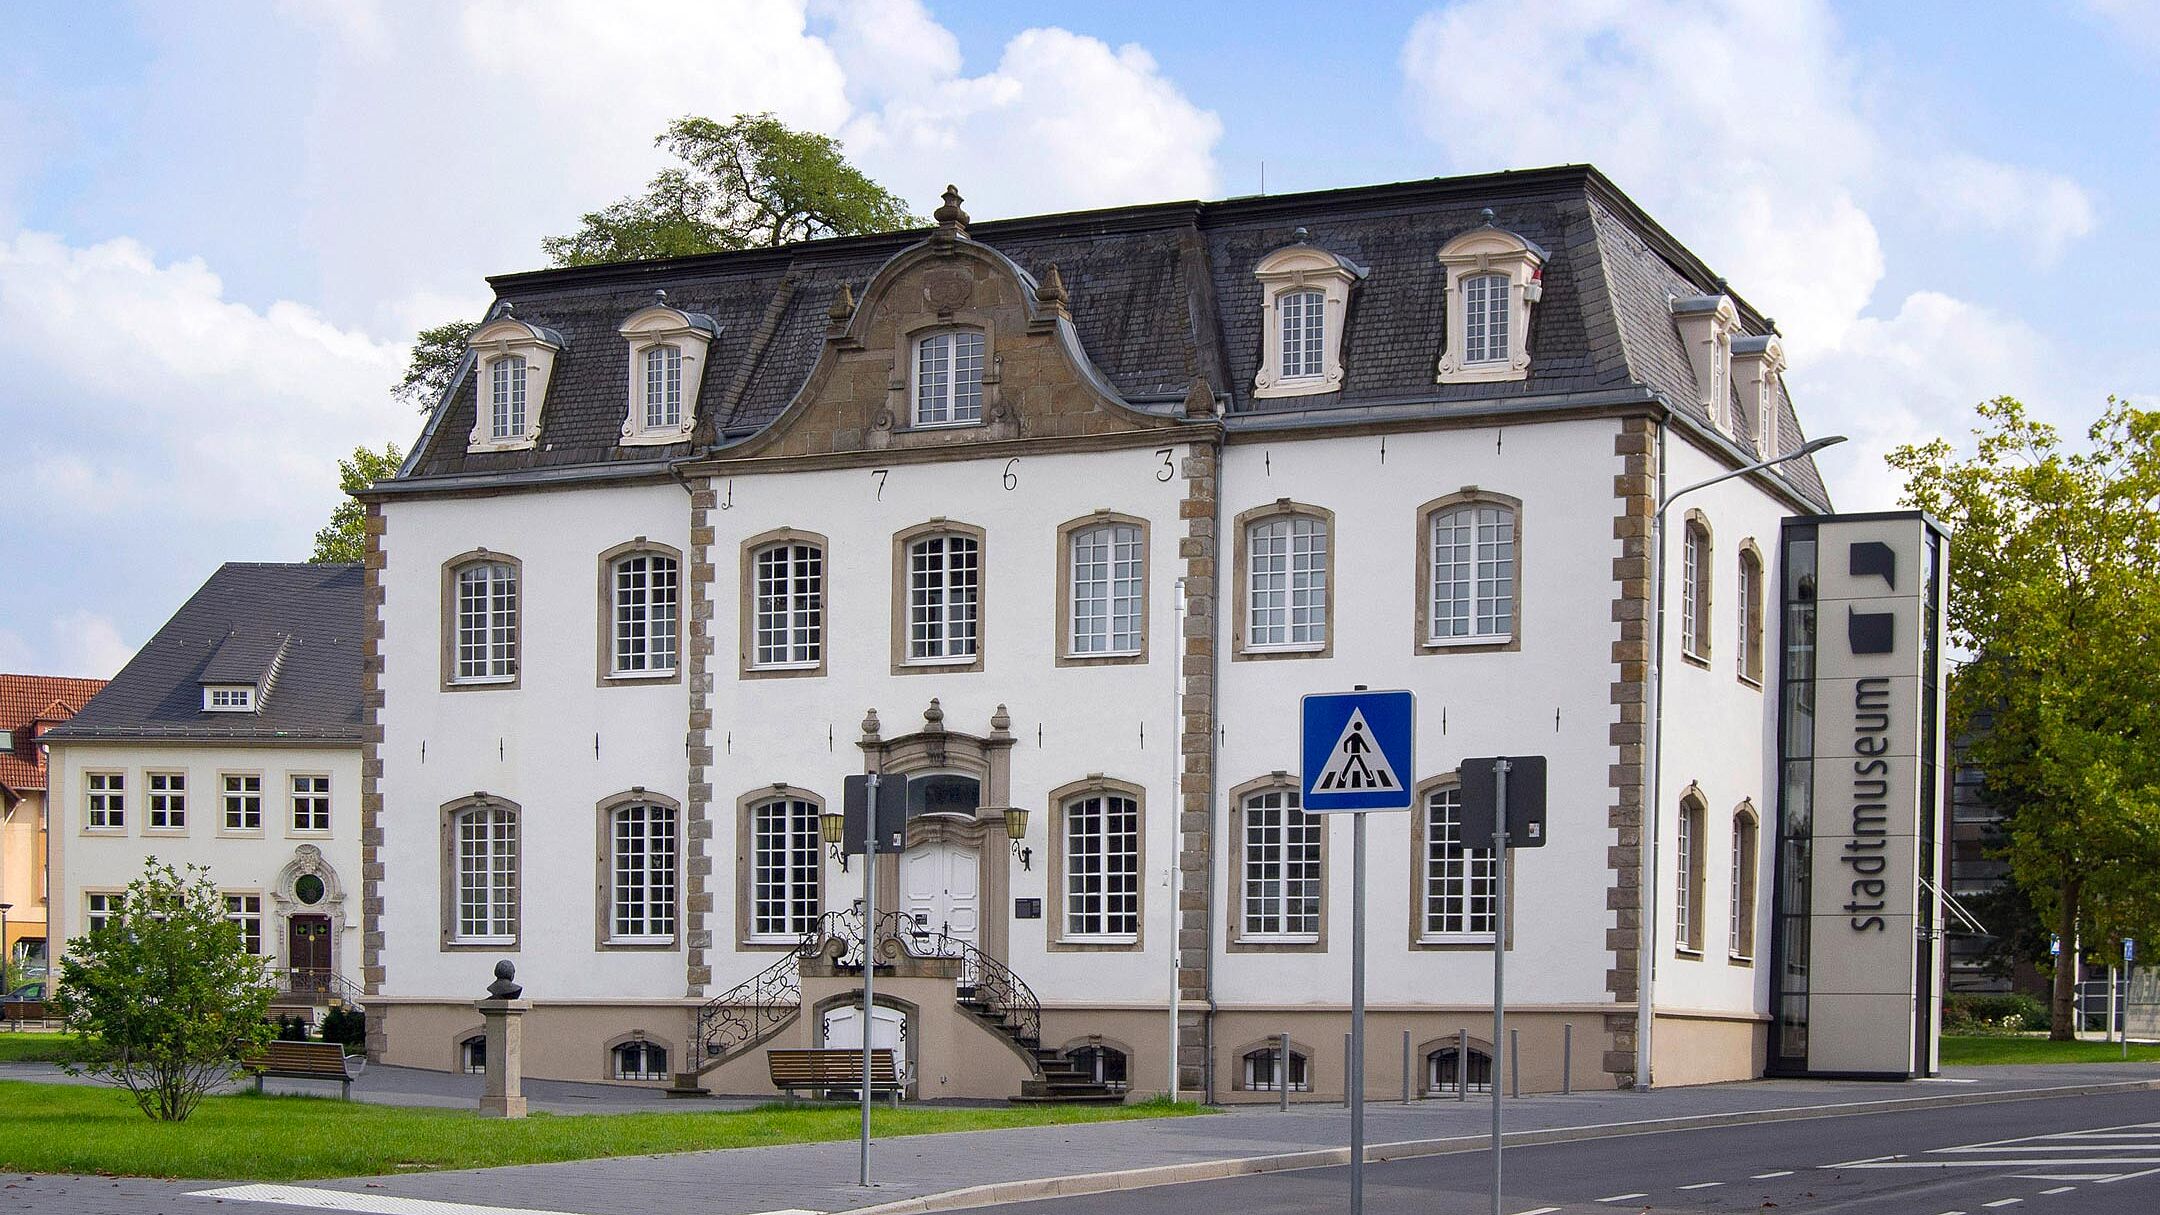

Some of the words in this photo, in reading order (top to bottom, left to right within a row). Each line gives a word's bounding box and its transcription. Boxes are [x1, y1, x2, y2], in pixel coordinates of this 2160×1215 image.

[871, 469, 889, 502] 7
[1003, 457, 1020, 491] 6
[1155, 448, 1175, 482] 3
[1840, 677, 1890, 933] stadtmuseum
